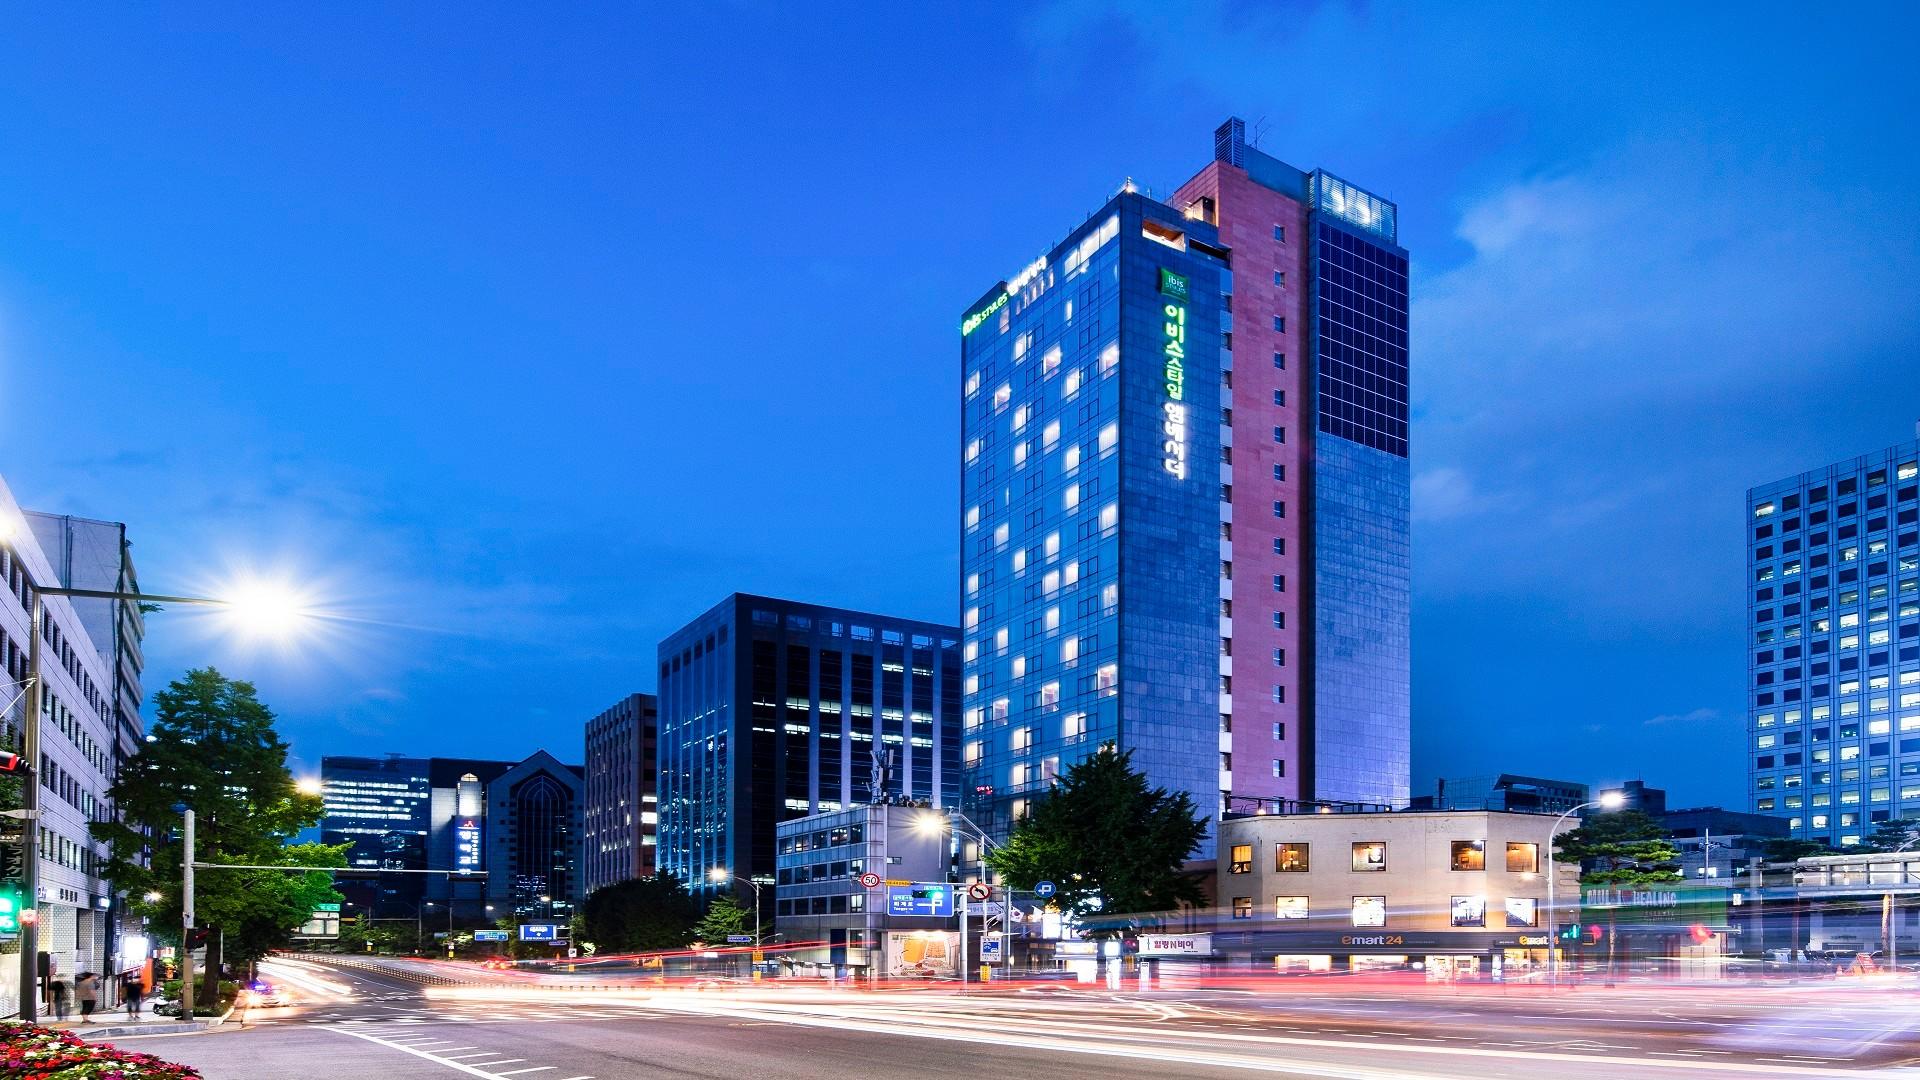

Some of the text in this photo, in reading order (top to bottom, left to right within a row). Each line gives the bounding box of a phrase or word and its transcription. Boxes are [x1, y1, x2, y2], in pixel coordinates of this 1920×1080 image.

[1168, 274, 1184, 288] ibis
[865, 876, 877, 885] 50
[1633, 891, 1677, 908] HEALING
